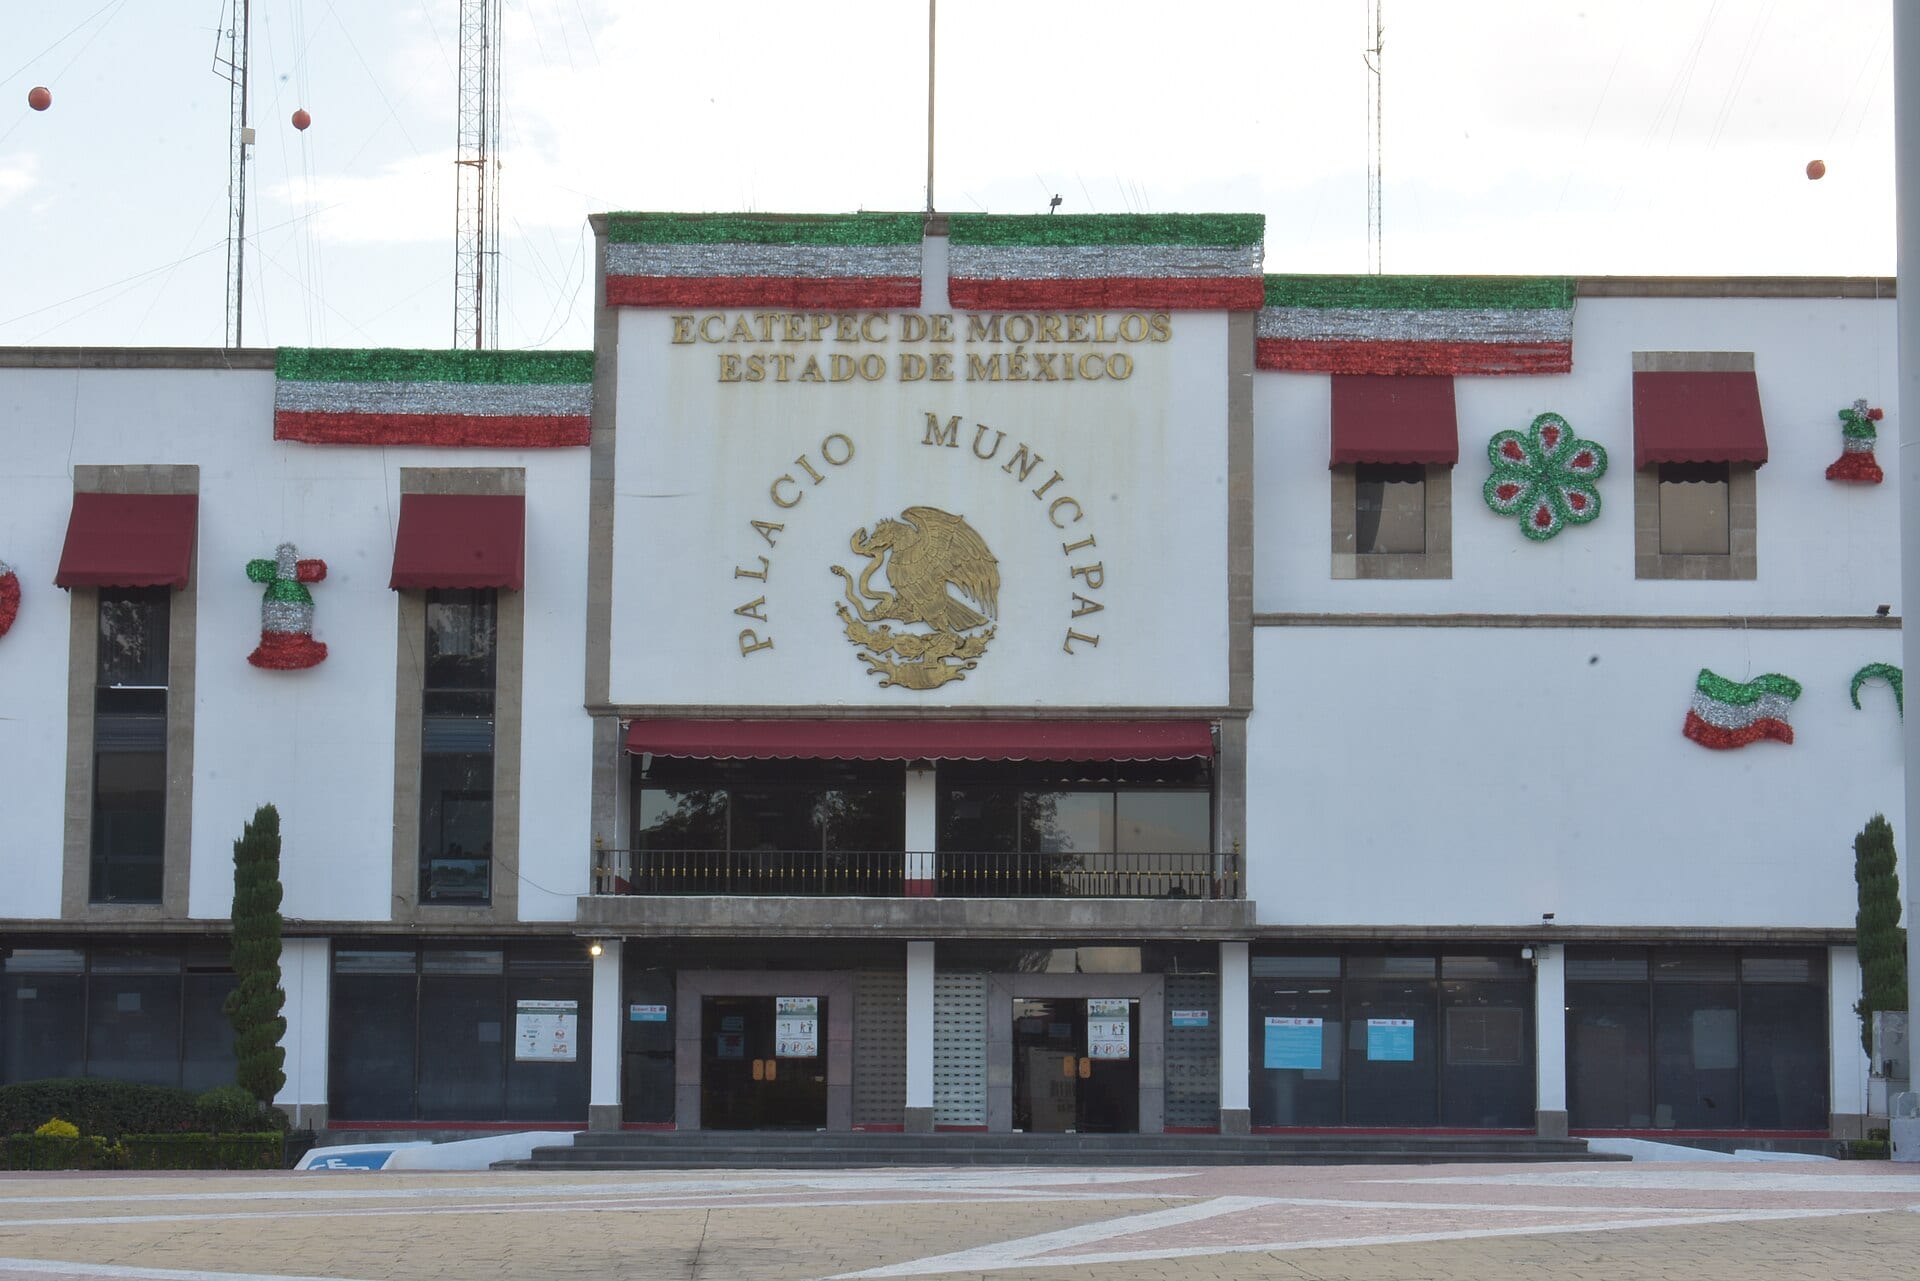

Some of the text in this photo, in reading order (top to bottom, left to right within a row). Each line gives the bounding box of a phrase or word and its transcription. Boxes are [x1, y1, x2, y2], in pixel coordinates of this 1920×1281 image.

[671, 312, 1173, 344] ECATEPEC DE MORELOS
[718, 345, 1134, 383] ESTADO DE MÉXICO
[734, 412, 1105, 657] PALACIO MUNICIPAL
